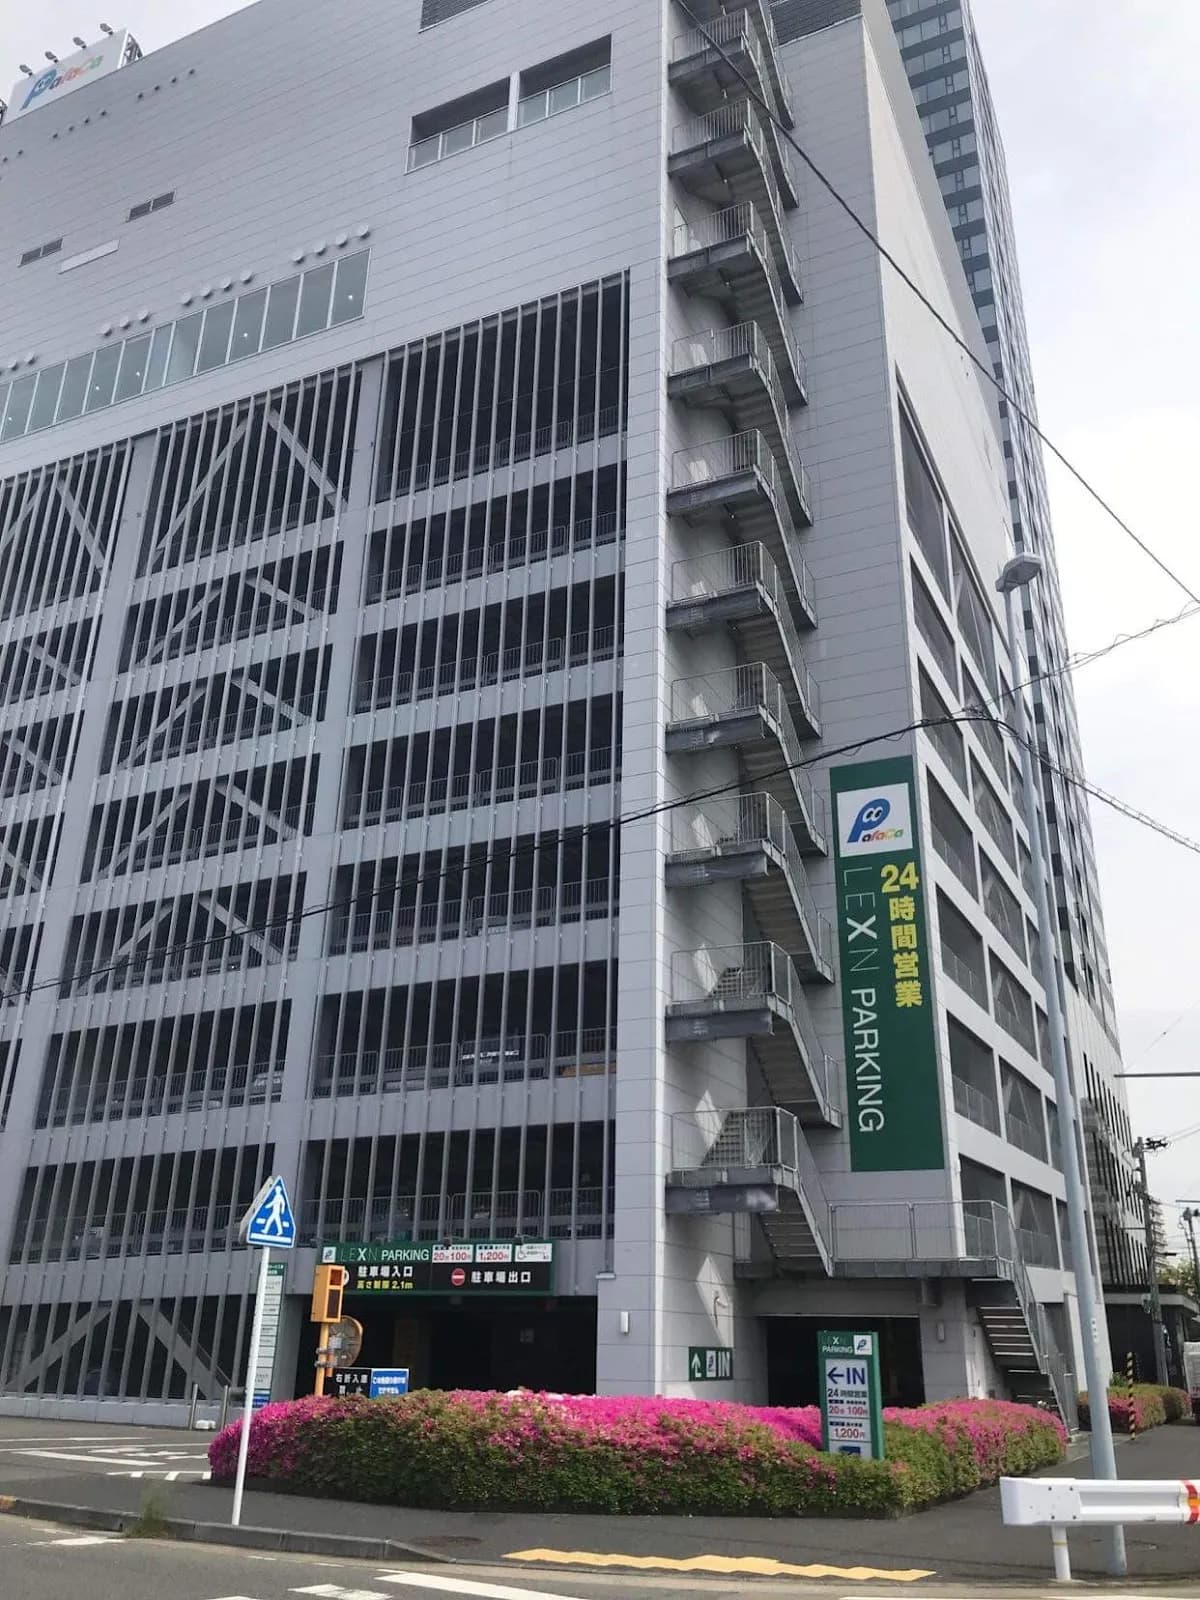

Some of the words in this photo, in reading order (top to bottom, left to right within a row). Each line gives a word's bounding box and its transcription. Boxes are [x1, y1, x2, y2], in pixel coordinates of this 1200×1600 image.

[843, 866, 880, 972] LEXN
[881, 862, 923, 1008] 24時間営業
[851, 987, 885, 1132] PARKING
[381, 1249, 430, 1261] PARKING
[845, 1367, 866, 1385] IN
